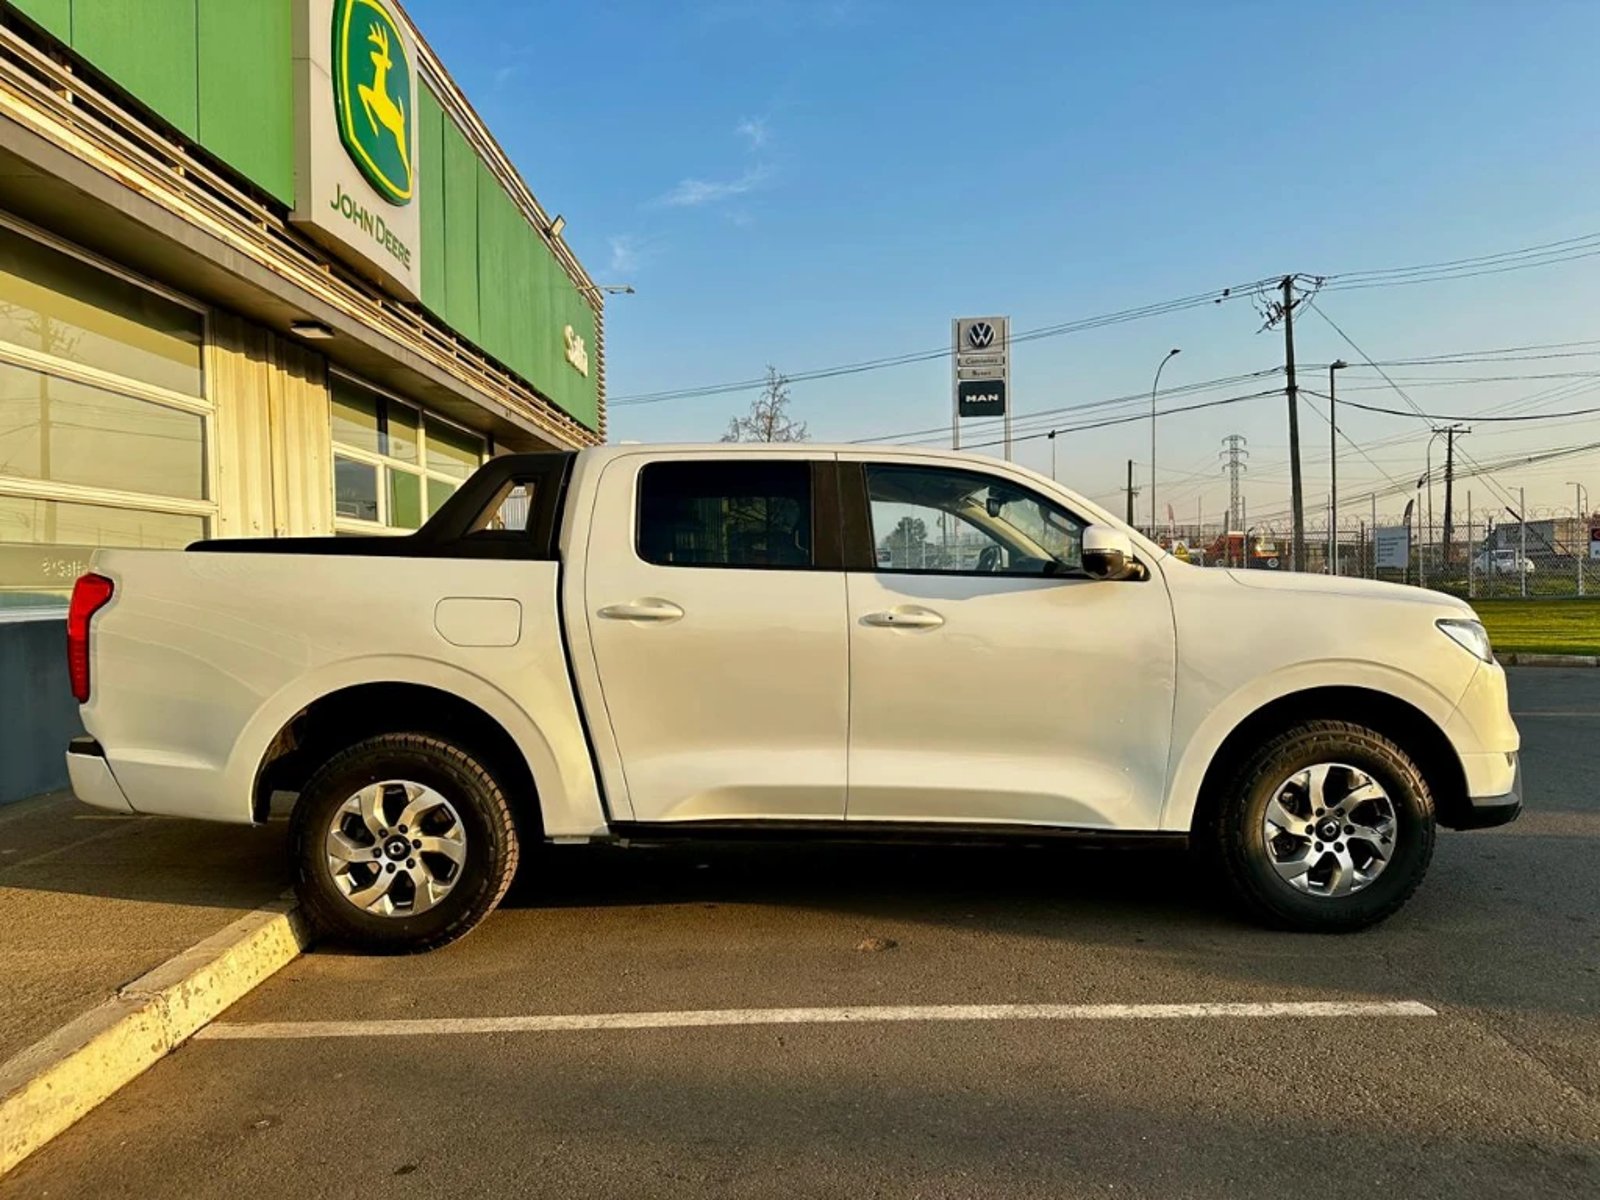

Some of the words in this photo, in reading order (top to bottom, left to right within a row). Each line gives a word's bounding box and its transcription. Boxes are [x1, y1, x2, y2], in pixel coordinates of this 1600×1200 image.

[330, 182, 374, 237] JOHN
[376, 215, 411, 271] DEERE
[965, 394, 999, 402] MAN
